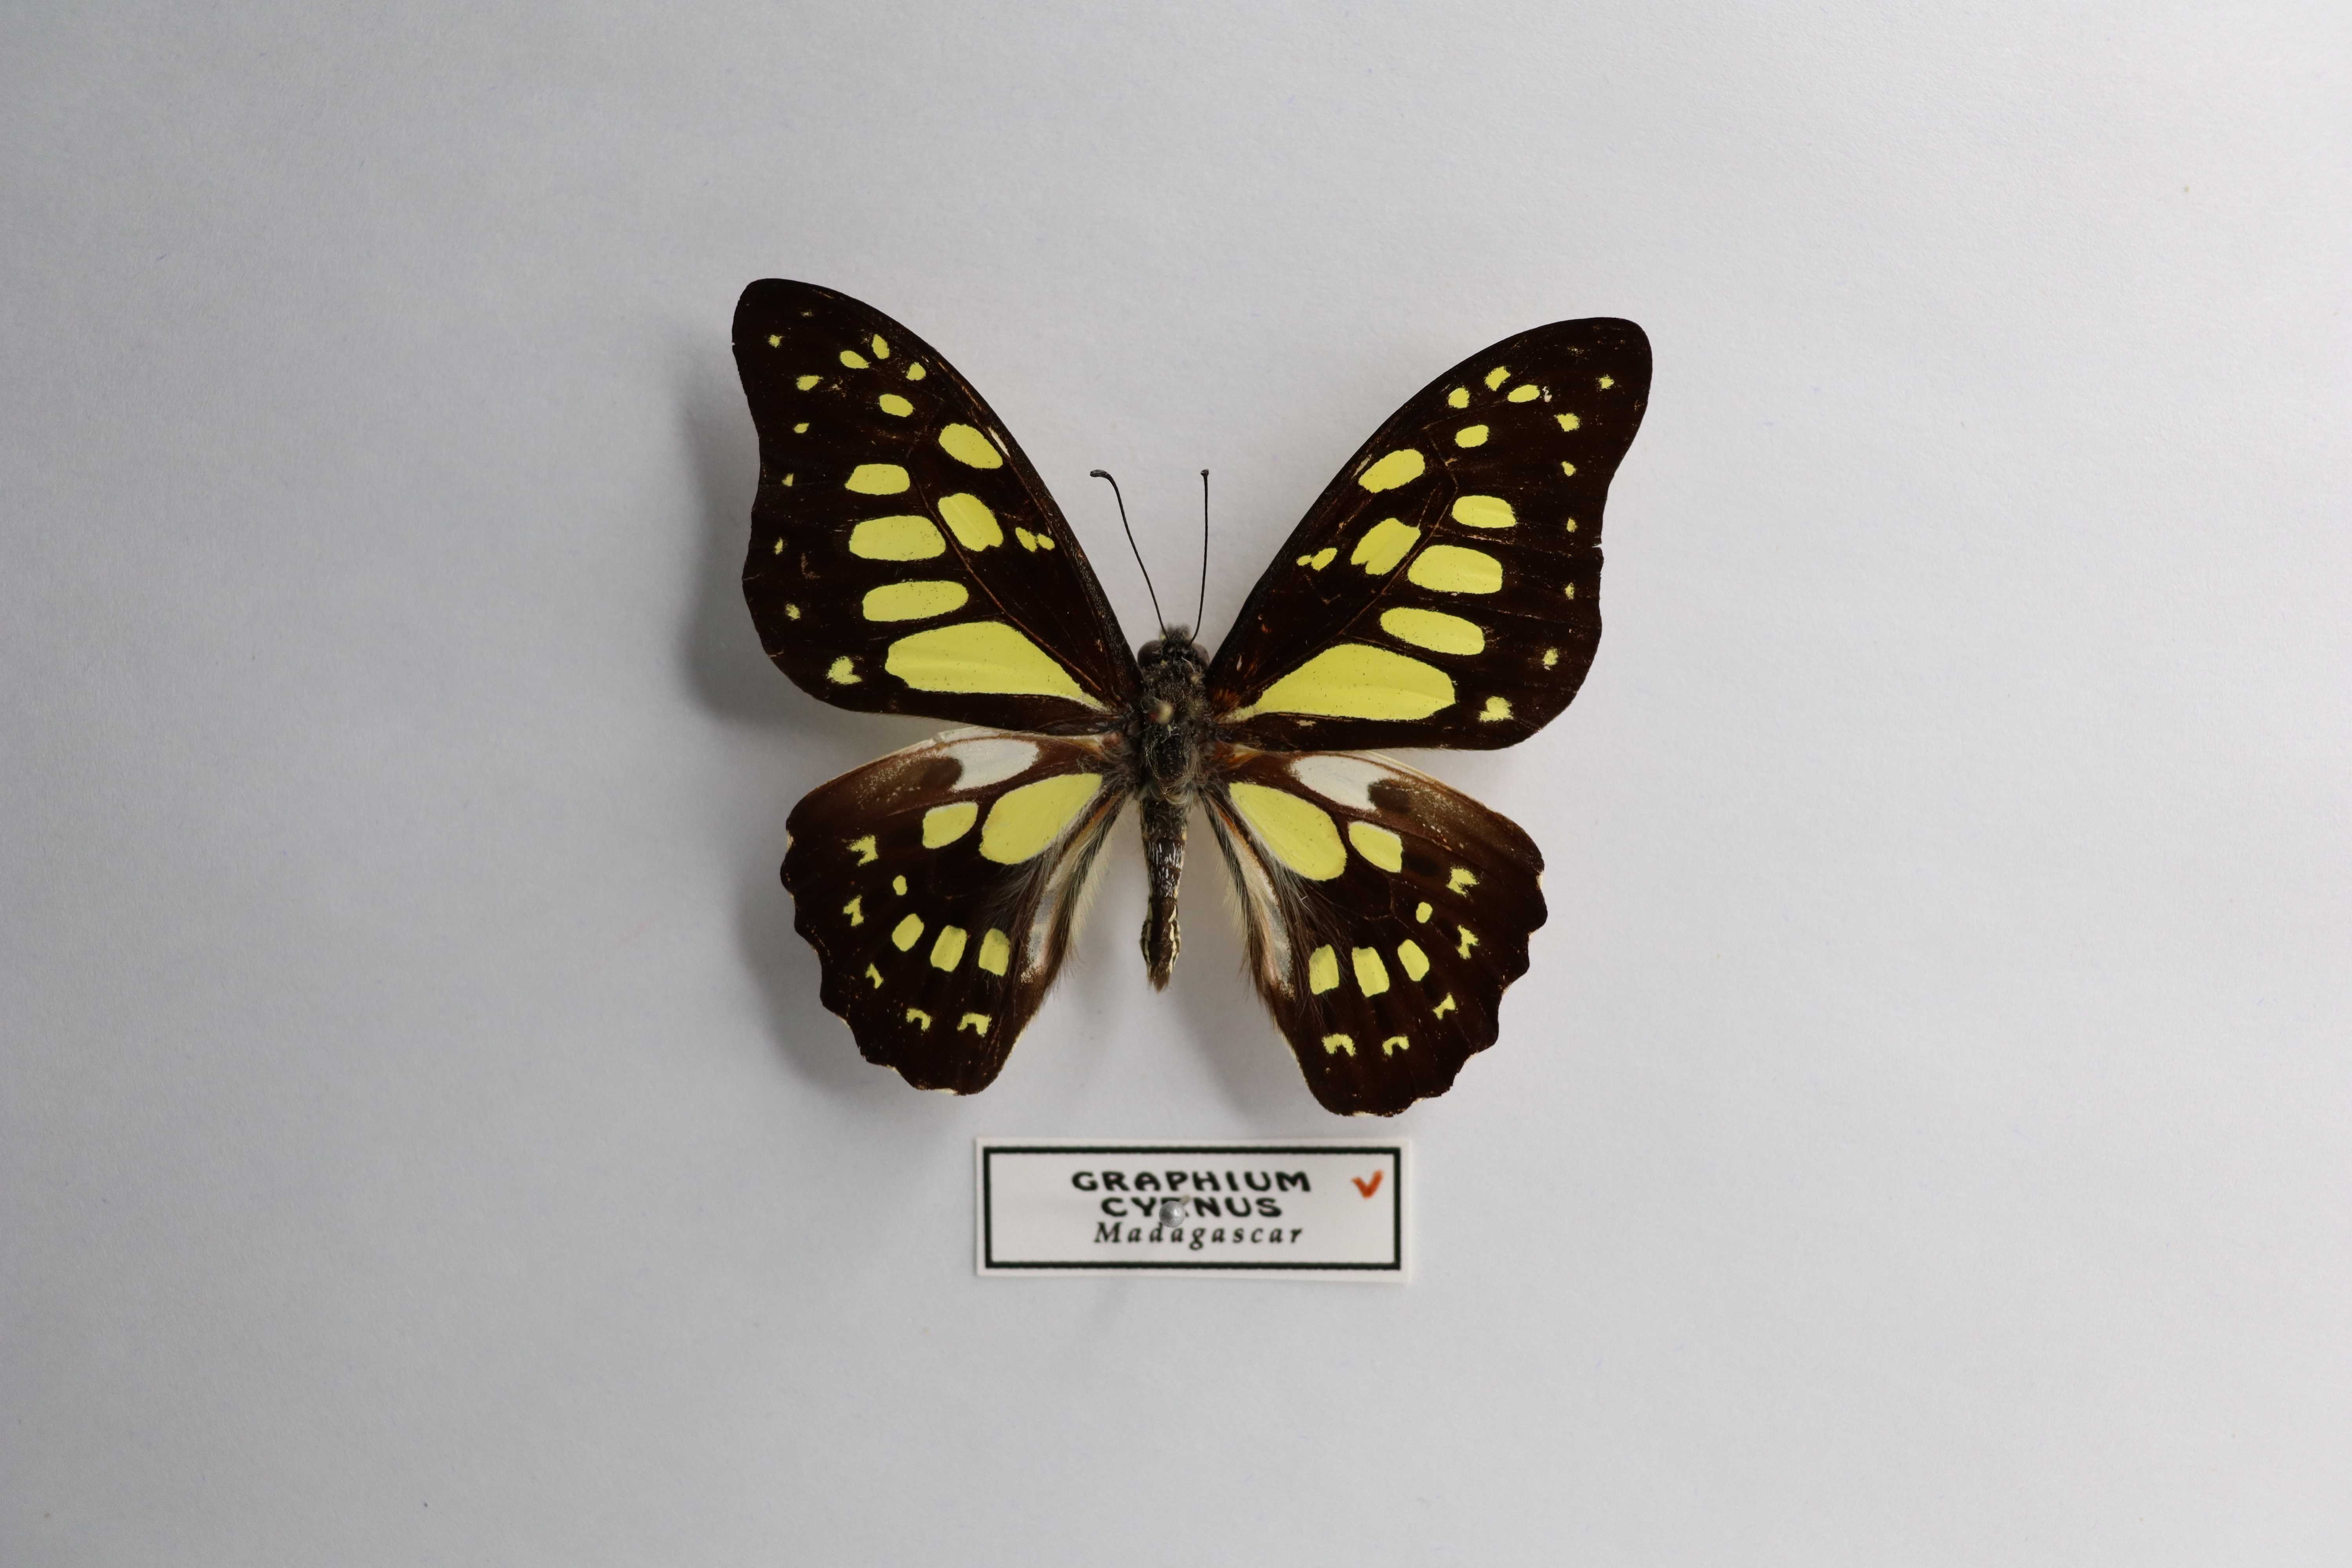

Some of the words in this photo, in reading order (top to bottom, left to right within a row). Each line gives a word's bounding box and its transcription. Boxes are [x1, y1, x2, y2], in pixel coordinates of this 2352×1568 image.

[1072, 1171, 1311, 1192] GRAPHIUM
[1101, 1197, 1282, 1218] CYNUS
[1094, 1221, 1302, 1250] Madagascar
